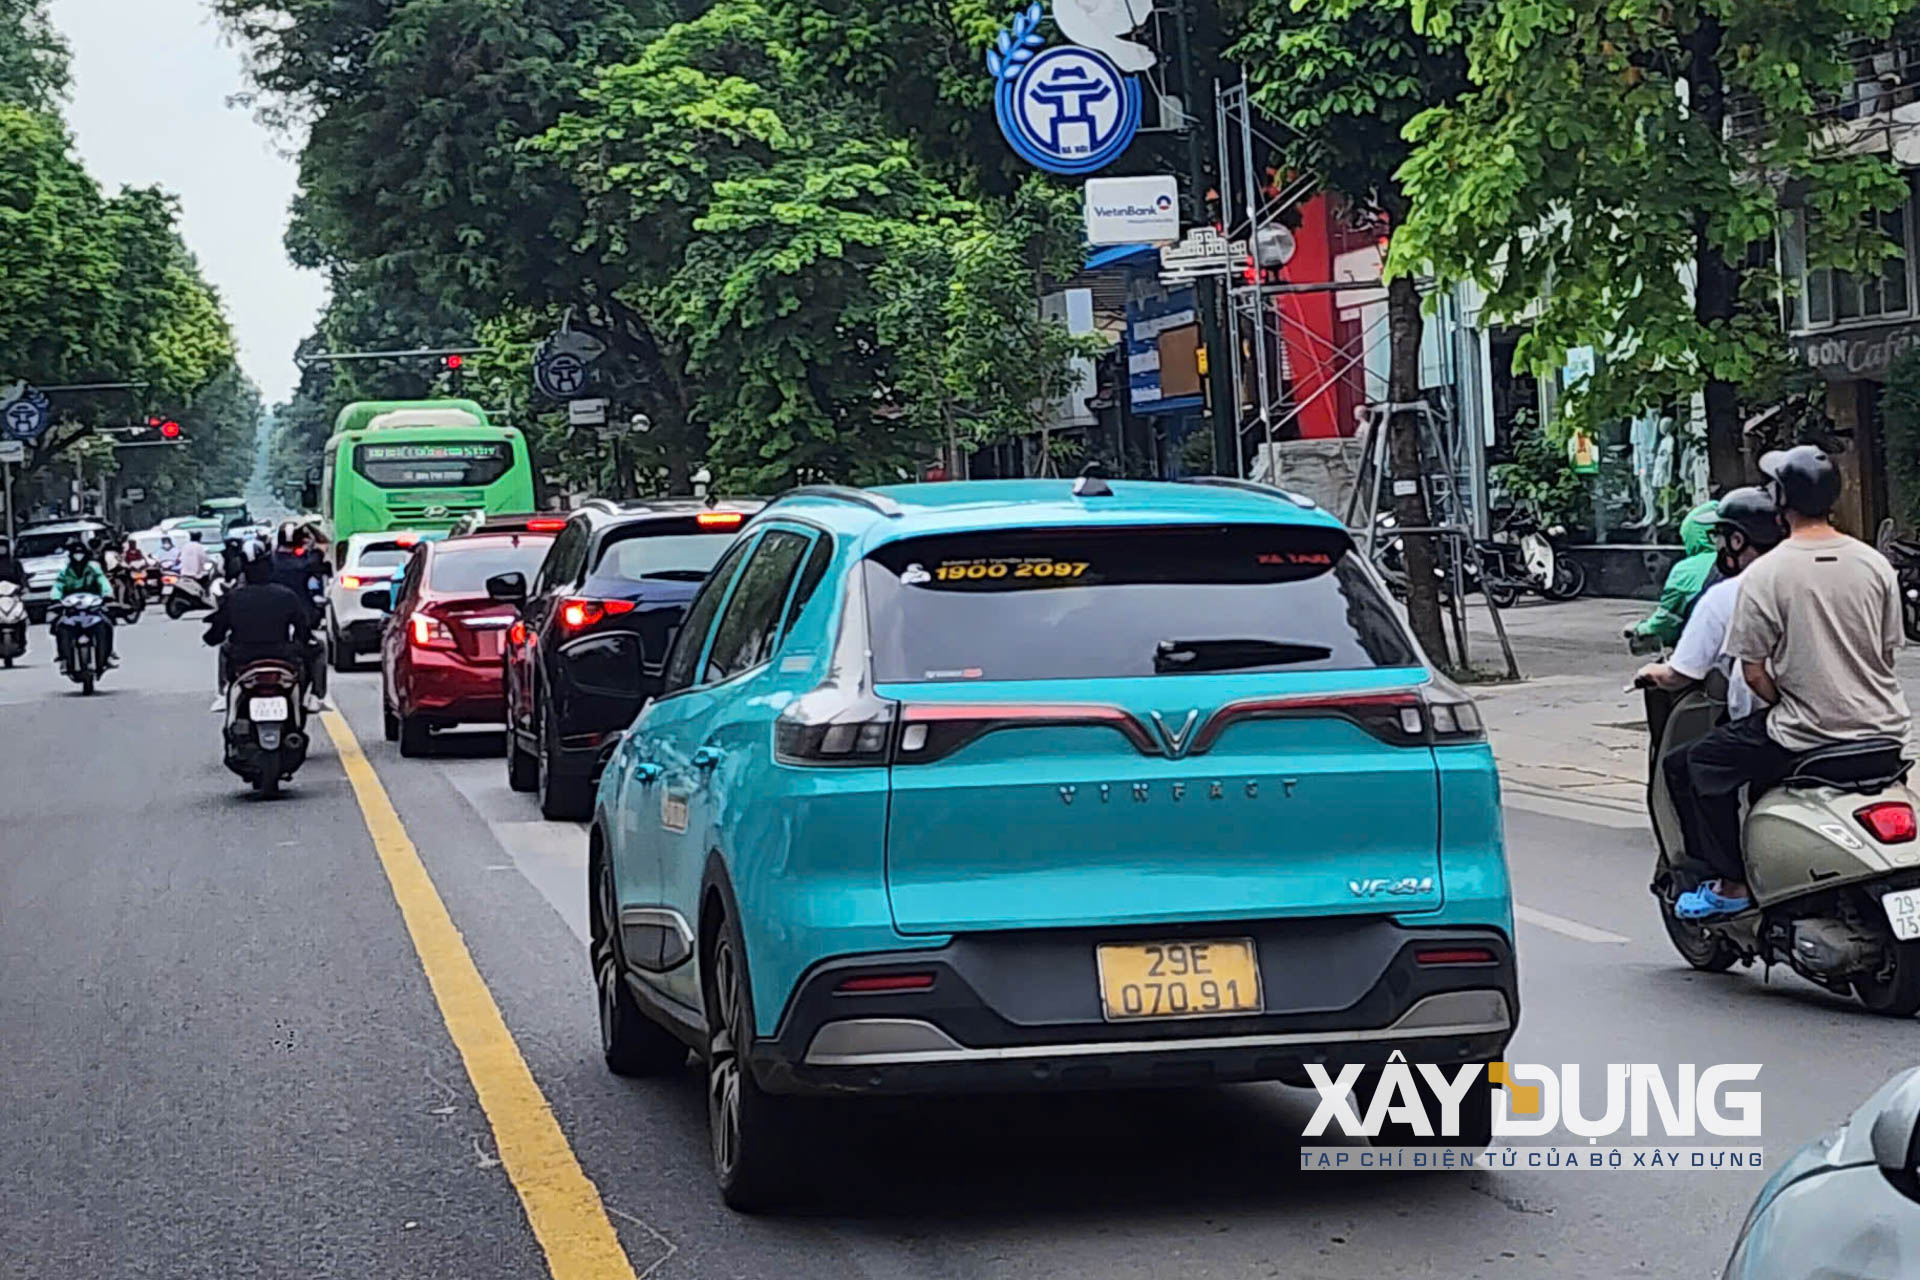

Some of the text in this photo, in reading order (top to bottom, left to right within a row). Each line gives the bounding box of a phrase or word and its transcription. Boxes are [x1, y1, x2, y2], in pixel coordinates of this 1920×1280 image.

[1094, 205, 1157, 218] VietinBank
[935, 563, 1008, 581] 1900
[1014, 561, 1090, 578] 2097
[1059, 777, 1299, 805] VINFAST
[1144, 943, 1213, 977] 29E
[1121, 978, 1241, 1015] 070.91
